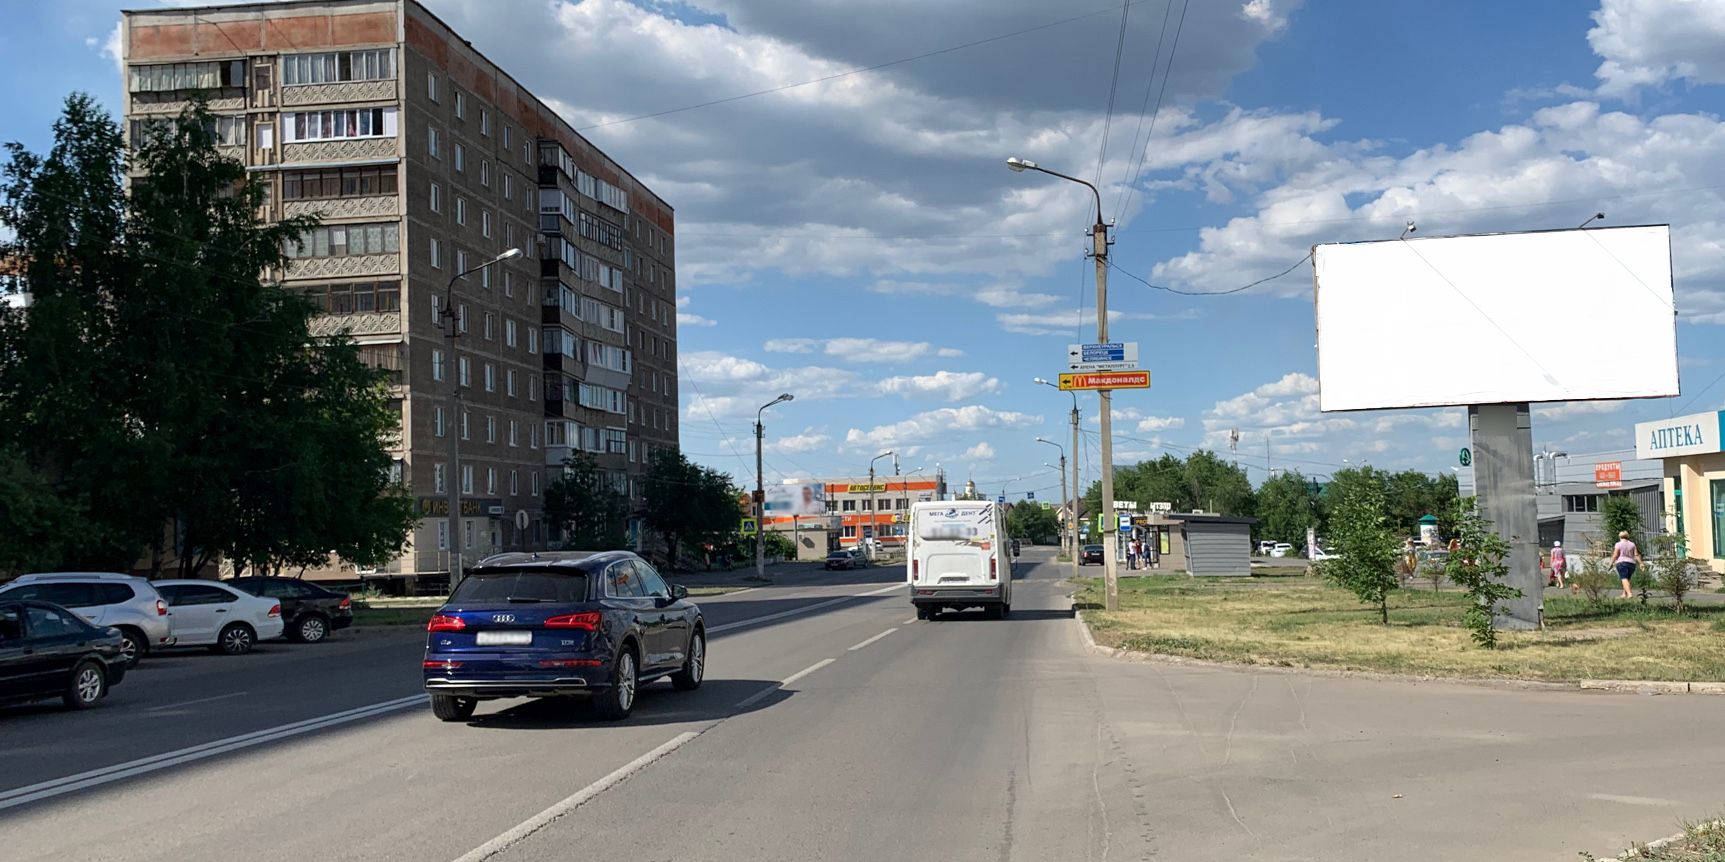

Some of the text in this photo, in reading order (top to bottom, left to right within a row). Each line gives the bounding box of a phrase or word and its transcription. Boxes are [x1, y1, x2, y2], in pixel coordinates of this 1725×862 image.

[1088, 376, 1146, 385] Макдоналдс
[1650, 424, 1703, 450] АПТЕКА
[1113, 501, 1136, 509] ВЕТЫ
